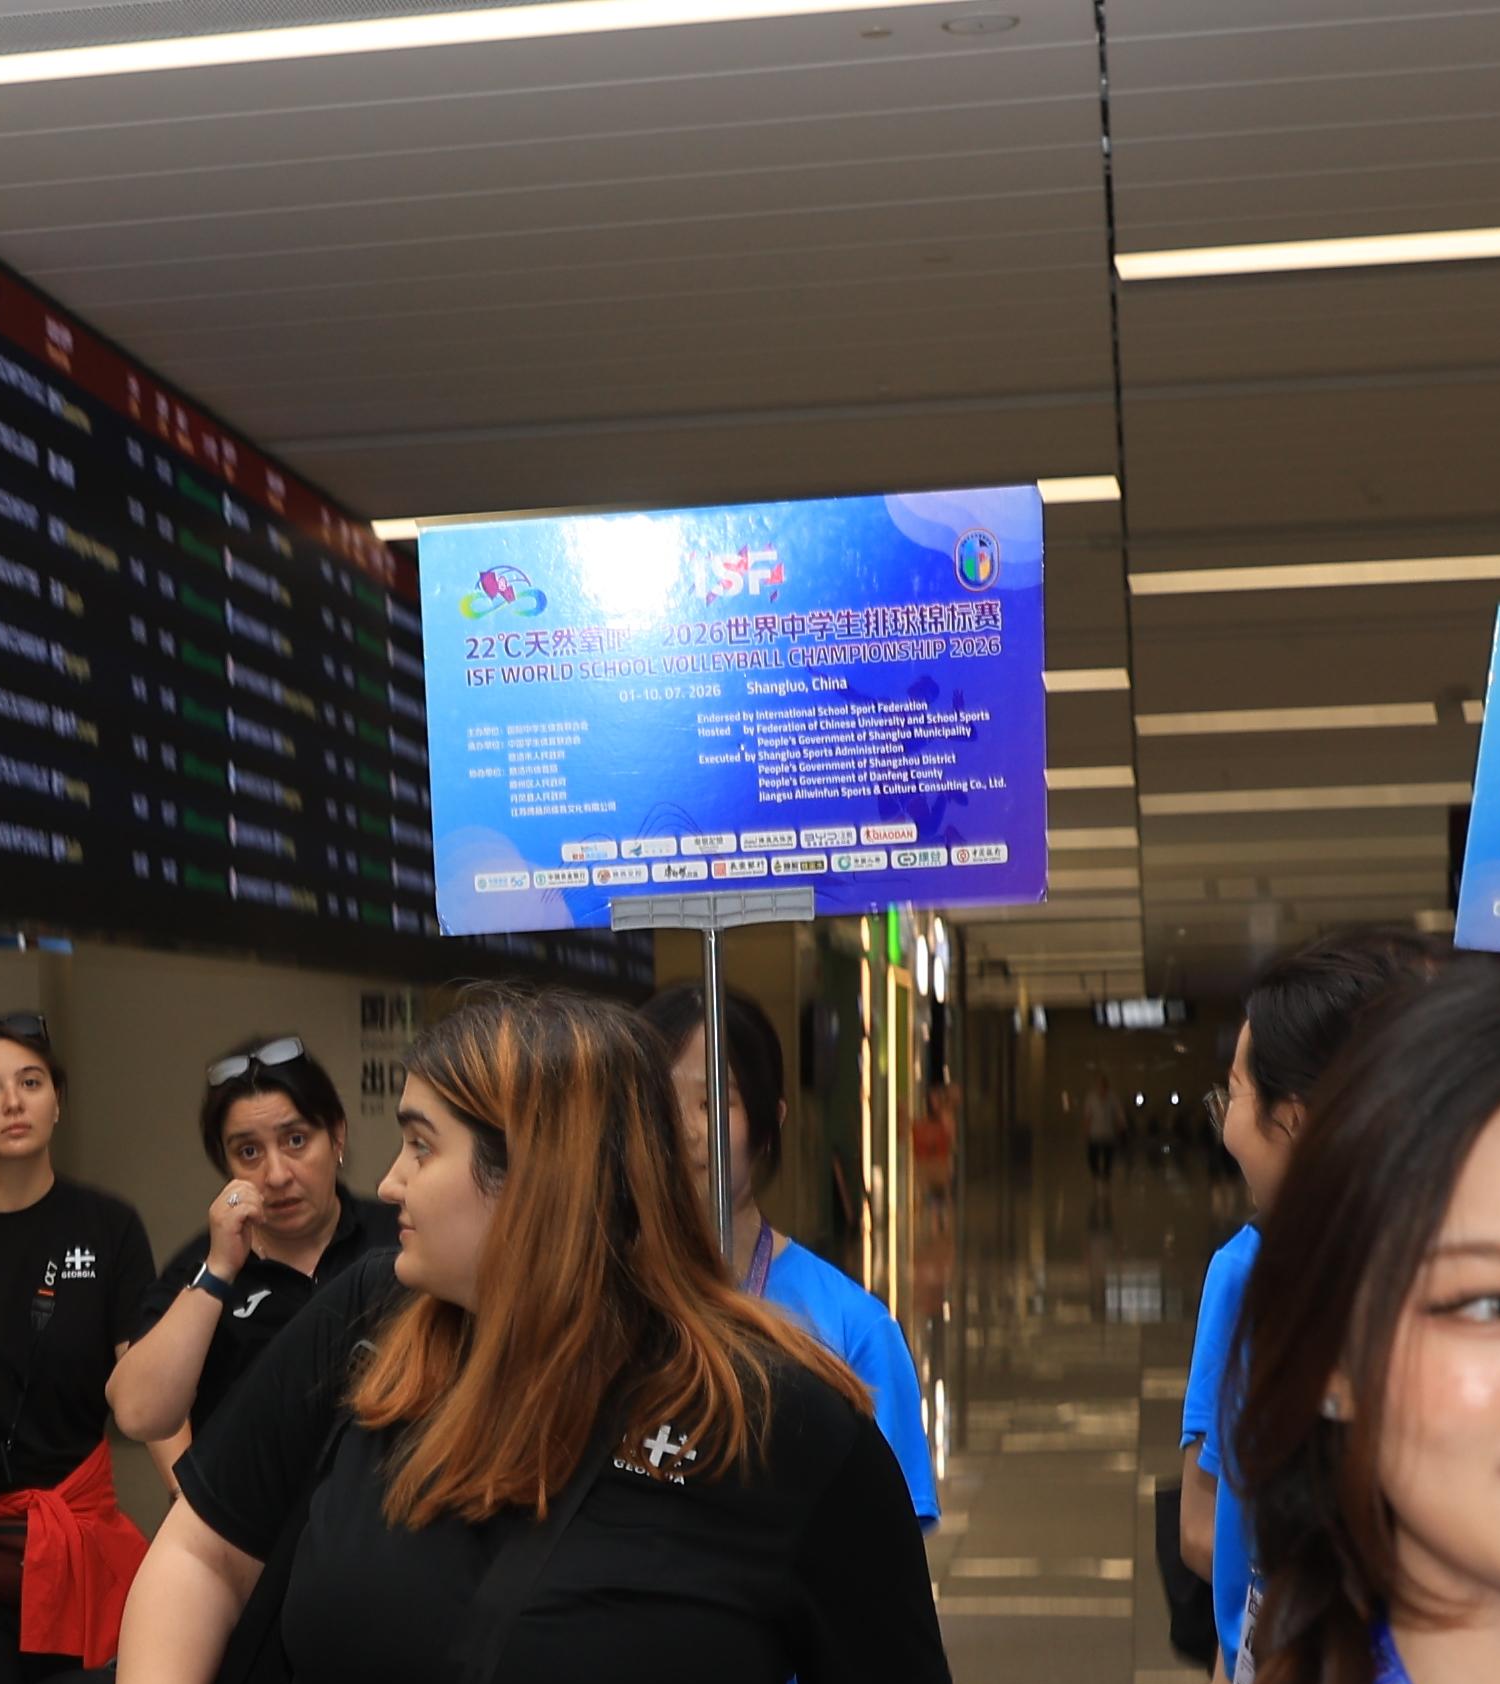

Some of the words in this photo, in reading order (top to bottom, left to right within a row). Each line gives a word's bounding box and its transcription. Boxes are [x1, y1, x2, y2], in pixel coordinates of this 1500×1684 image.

[694, 550, 778, 598] ISF
[466, 668, 495, 687] ISF
[501, 662, 573, 685] WORLD
[580, 658, 657, 680] SCHOOL
[663, 649, 782, 674] VOLLEYBALL
[789, 641, 946, 668] CHAMPIONSHIP
[949, 637, 1001, 658] 2026
[688, 684, 721, 699] 2026
[746, 679, 808, 697] Shangluo,
[812, 677, 847, 691] China
[697, 712, 740, 722] Endorsed
[743, 712, 753, 722] by
[756, 707, 815, 720] International
[817, 706, 848, 716] School
[850, 705, 875, 716] Sport
[878, 701, 927, 712] Federation
[698, 725, 730, 736] Hosted
[743, 725, 754, 736] by
[757, 722, 806, 734] Federation
[808, 721, 817, 730] of
[820, 719, 855, 730] Chinese
[858, 715, 906, 728] University
[908, 714, 924, 724] and
[927, 712, 958, 722] School
[960, 711, 990, 722] Sports
[757, 736, 796, 748] People's
[799, 733, 855, 745] Government
[857, 732, 866, 740] of
[869, 729, 912, 742] Shangluo
[914, 726, 971, 738] Municipality
[699, 752, 740, 764] Executed
[745, 752, 756, 763] by
[758, 749, 800, 762] Shangluo
[803, 747, 833, 758] Sports
[835, 743, 904, 756] Administration
[758, 764, 797, 775] People's
[799, 760, 855, 772] Government
[857, 759, 867, 767] of
[869, 756, 920, 768] Shangzhou
[922, 753, 956, 765] District
[759, 777, 797, 789] People's
[799, 774, 855, 785] Government
[857, 772, 867, 782] of
[870, 770, 908, 782] Danfeng
[910, 768, 943, 780] County
[841, 785, 871, 798] Sports
[883, 782, 916, 794] Culture
[919, 780, 968, 791] Consulting
[969, 779, 986, 790] Co.,
[989, 777, 1006, 788] Ltd.
[60, 1269, 97, 1280] GEORGIA
